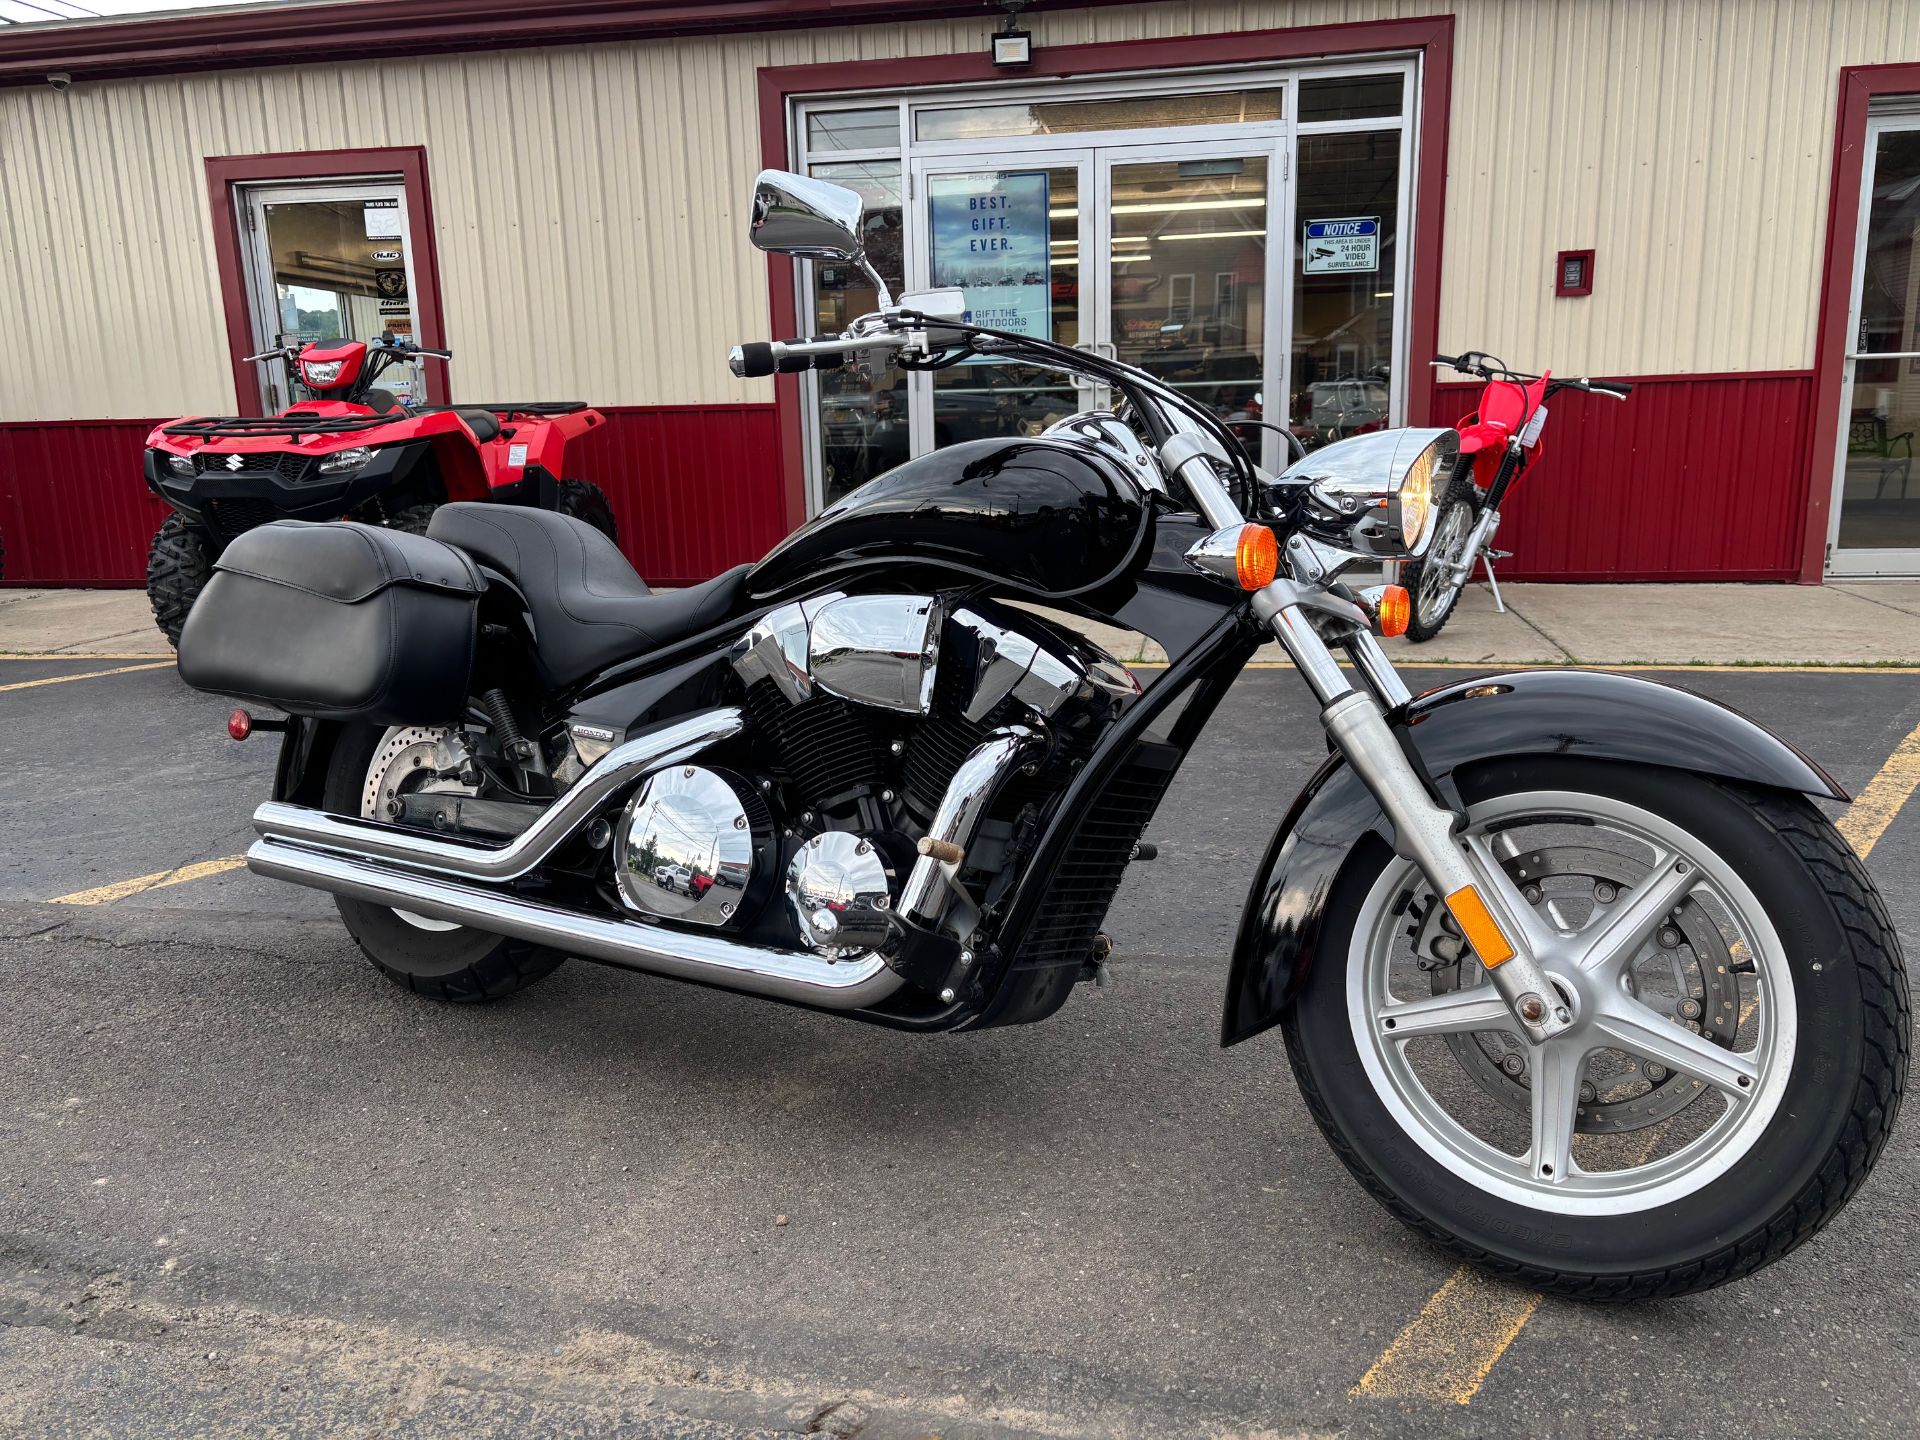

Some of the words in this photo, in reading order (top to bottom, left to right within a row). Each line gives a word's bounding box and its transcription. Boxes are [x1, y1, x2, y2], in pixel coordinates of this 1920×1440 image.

[967, 173, 1007, 181] POLARIS
[969, 196, 1012, 210] BEST.
[972, 217, 1010, 231] GIFT.
[1323, 223, 1361, 235] NOTICE
[970, 238, 1013, 251] EVER.
[976, 310, 996, 318] GIFT
[999, 309, 1017, 317] THE
[976, 318, 1027, 327] OUTDOORS
[577, 728, 607, 738] HONDA
